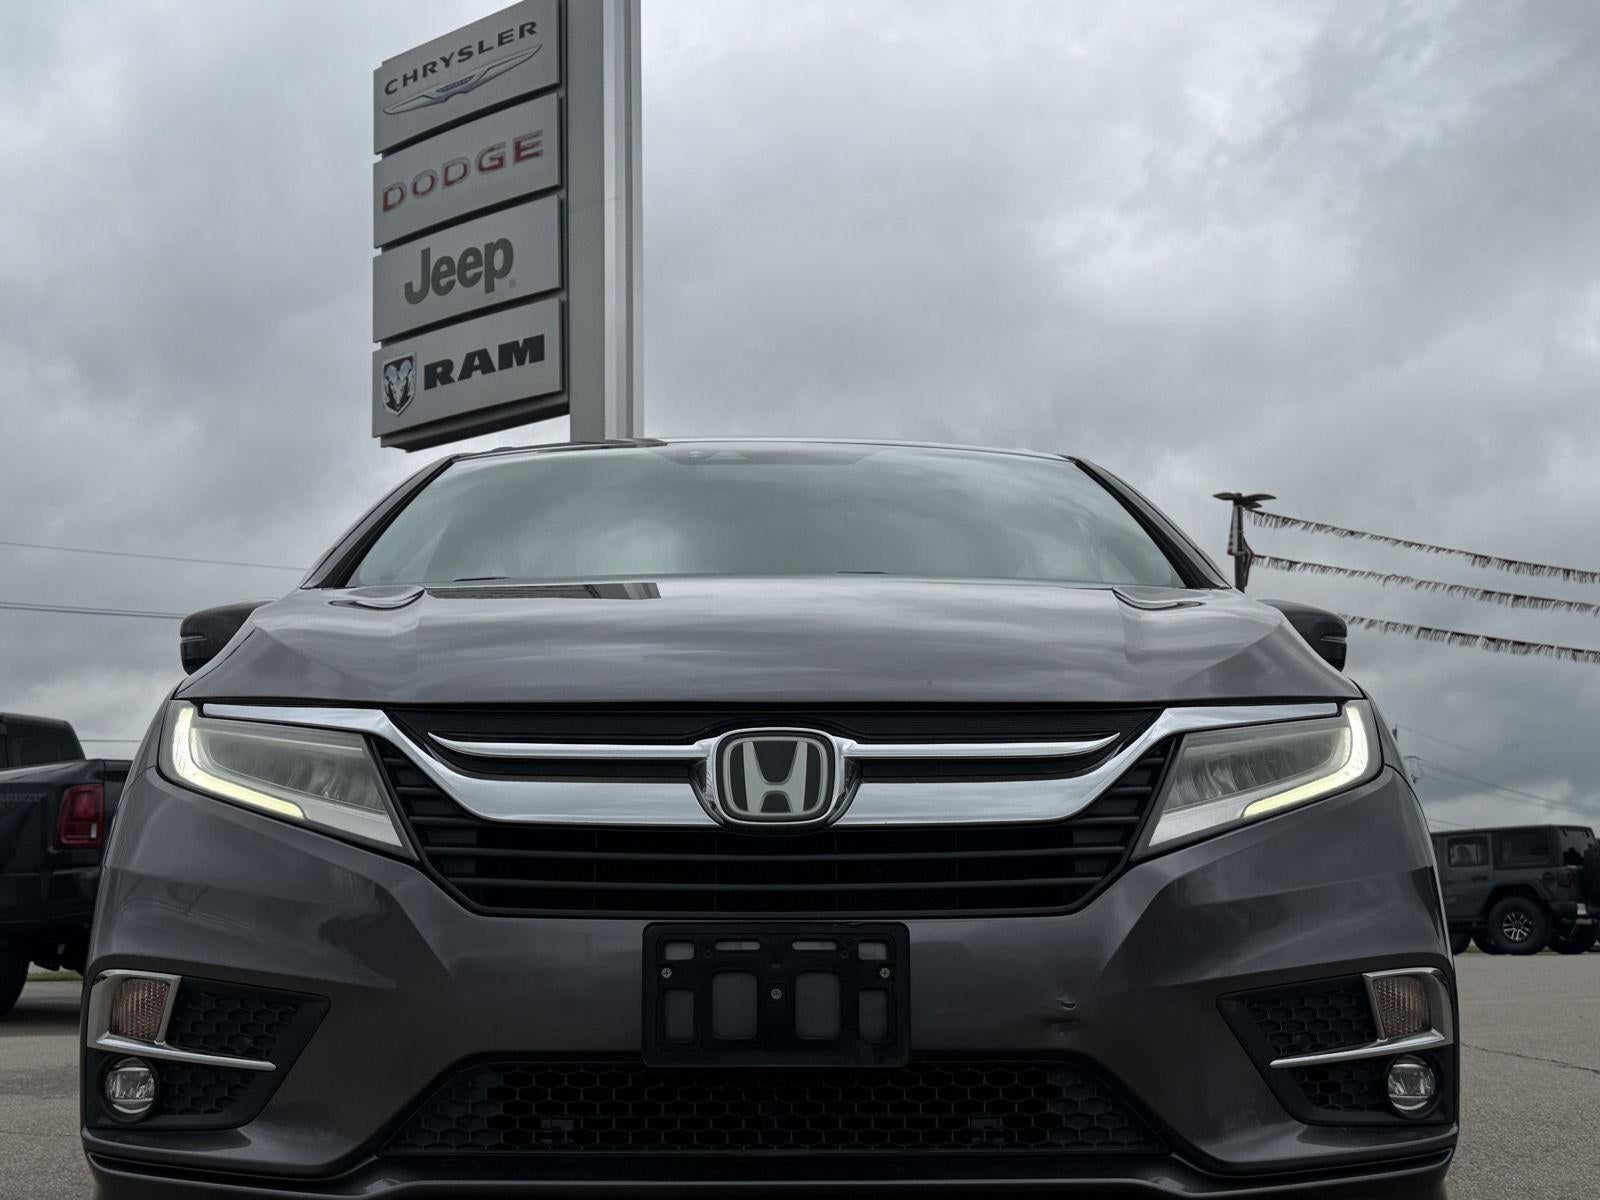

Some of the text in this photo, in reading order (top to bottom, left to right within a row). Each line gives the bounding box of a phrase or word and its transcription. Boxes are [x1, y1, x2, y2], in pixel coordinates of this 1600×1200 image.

[384, 20, 538, 95] CHRYSLER
[381, 130, 544, 212] DODGE
[404, 237, 514, 304] Jeep
[424, 334, 545, 390] RAM
